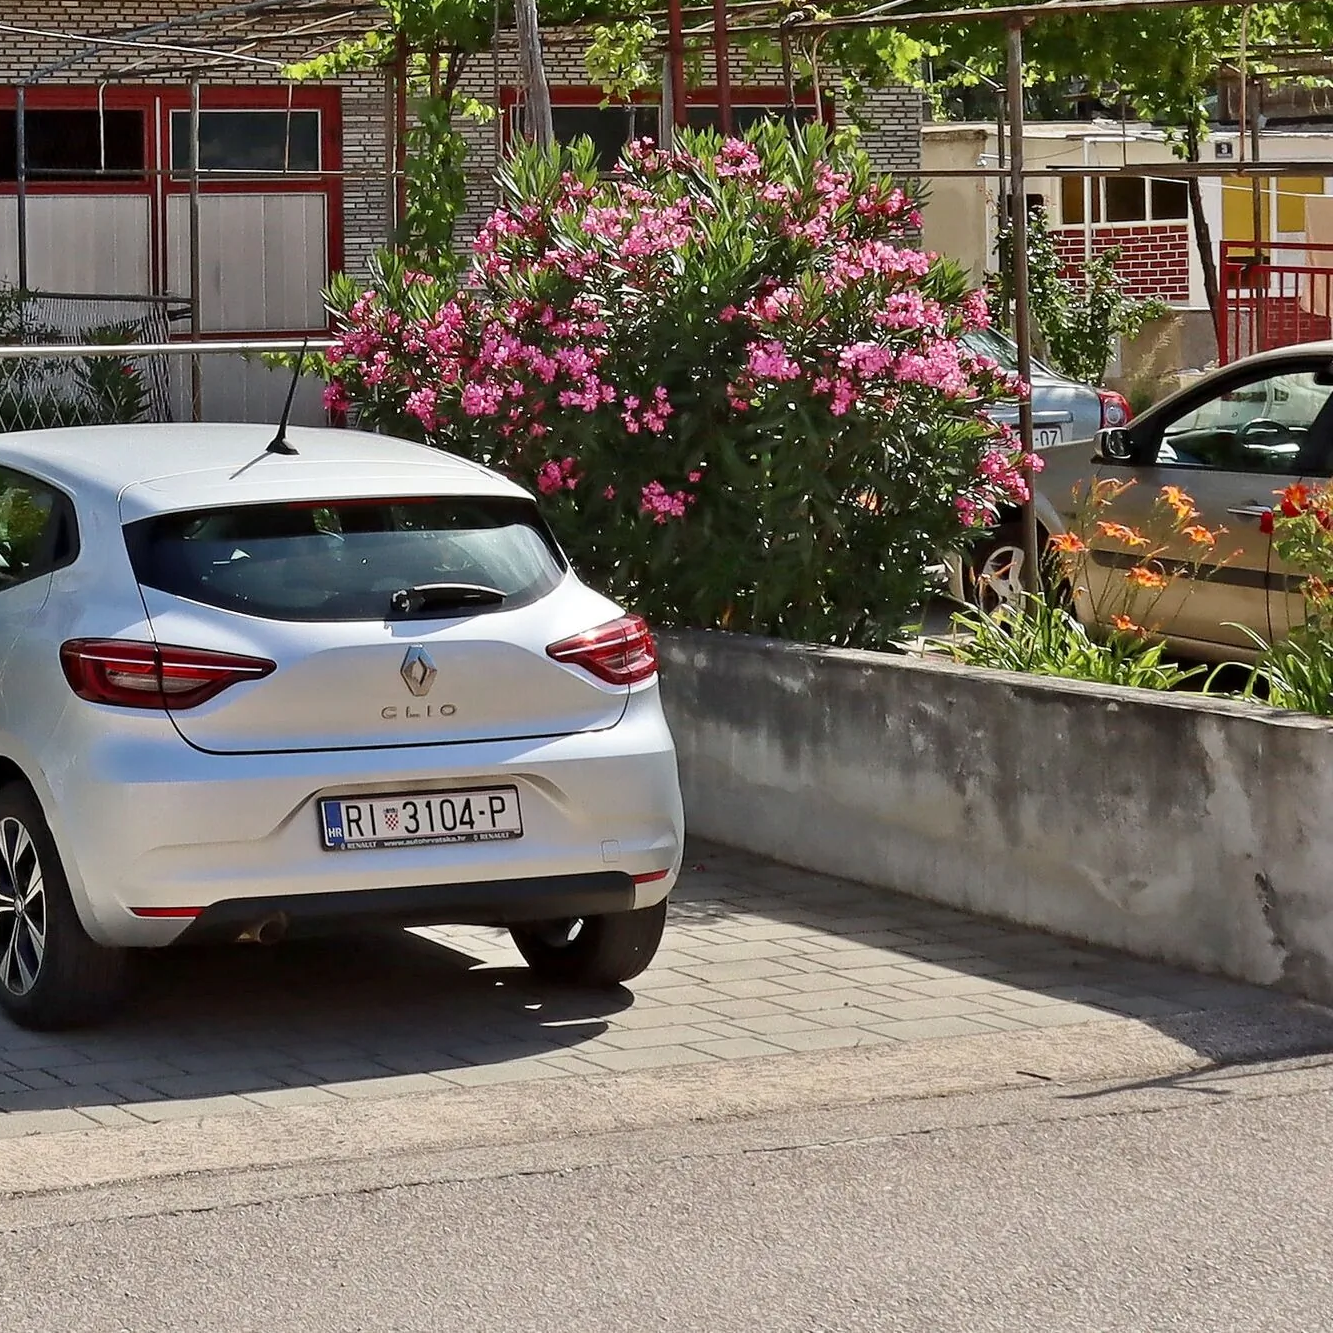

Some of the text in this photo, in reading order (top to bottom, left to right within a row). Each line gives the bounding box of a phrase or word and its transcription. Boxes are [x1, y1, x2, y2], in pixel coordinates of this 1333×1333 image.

[380, 704, 457, 720] CLIO
[345, 796, 506, 837] RI 3104-P
[328, 827, 343, 838] HR
